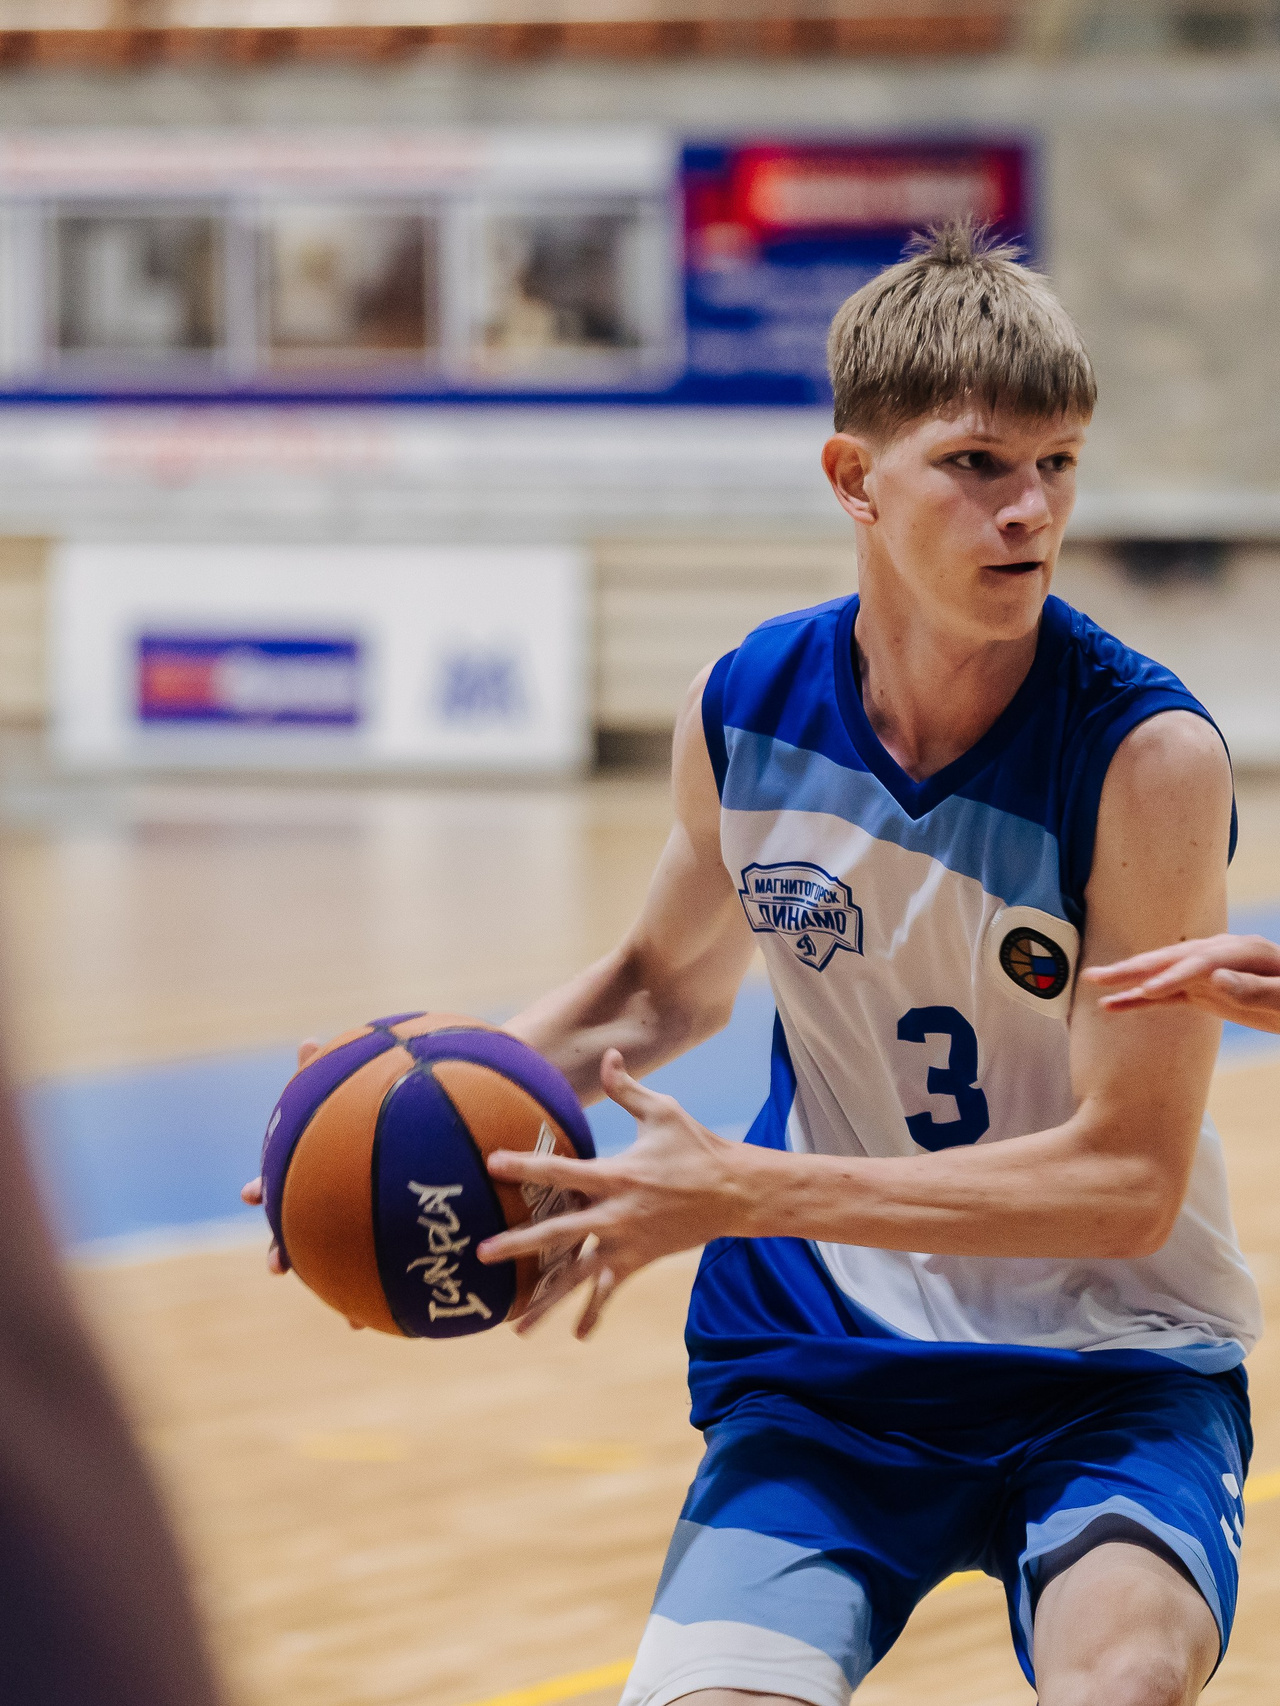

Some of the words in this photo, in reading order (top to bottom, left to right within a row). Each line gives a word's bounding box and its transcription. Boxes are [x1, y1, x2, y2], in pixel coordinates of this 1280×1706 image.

[754, 878, 841, 903] МАГНИТОГОРСК
[758, 904, 847, 935] ДИНАМО
[897, 1005, 990, 1153] 3
